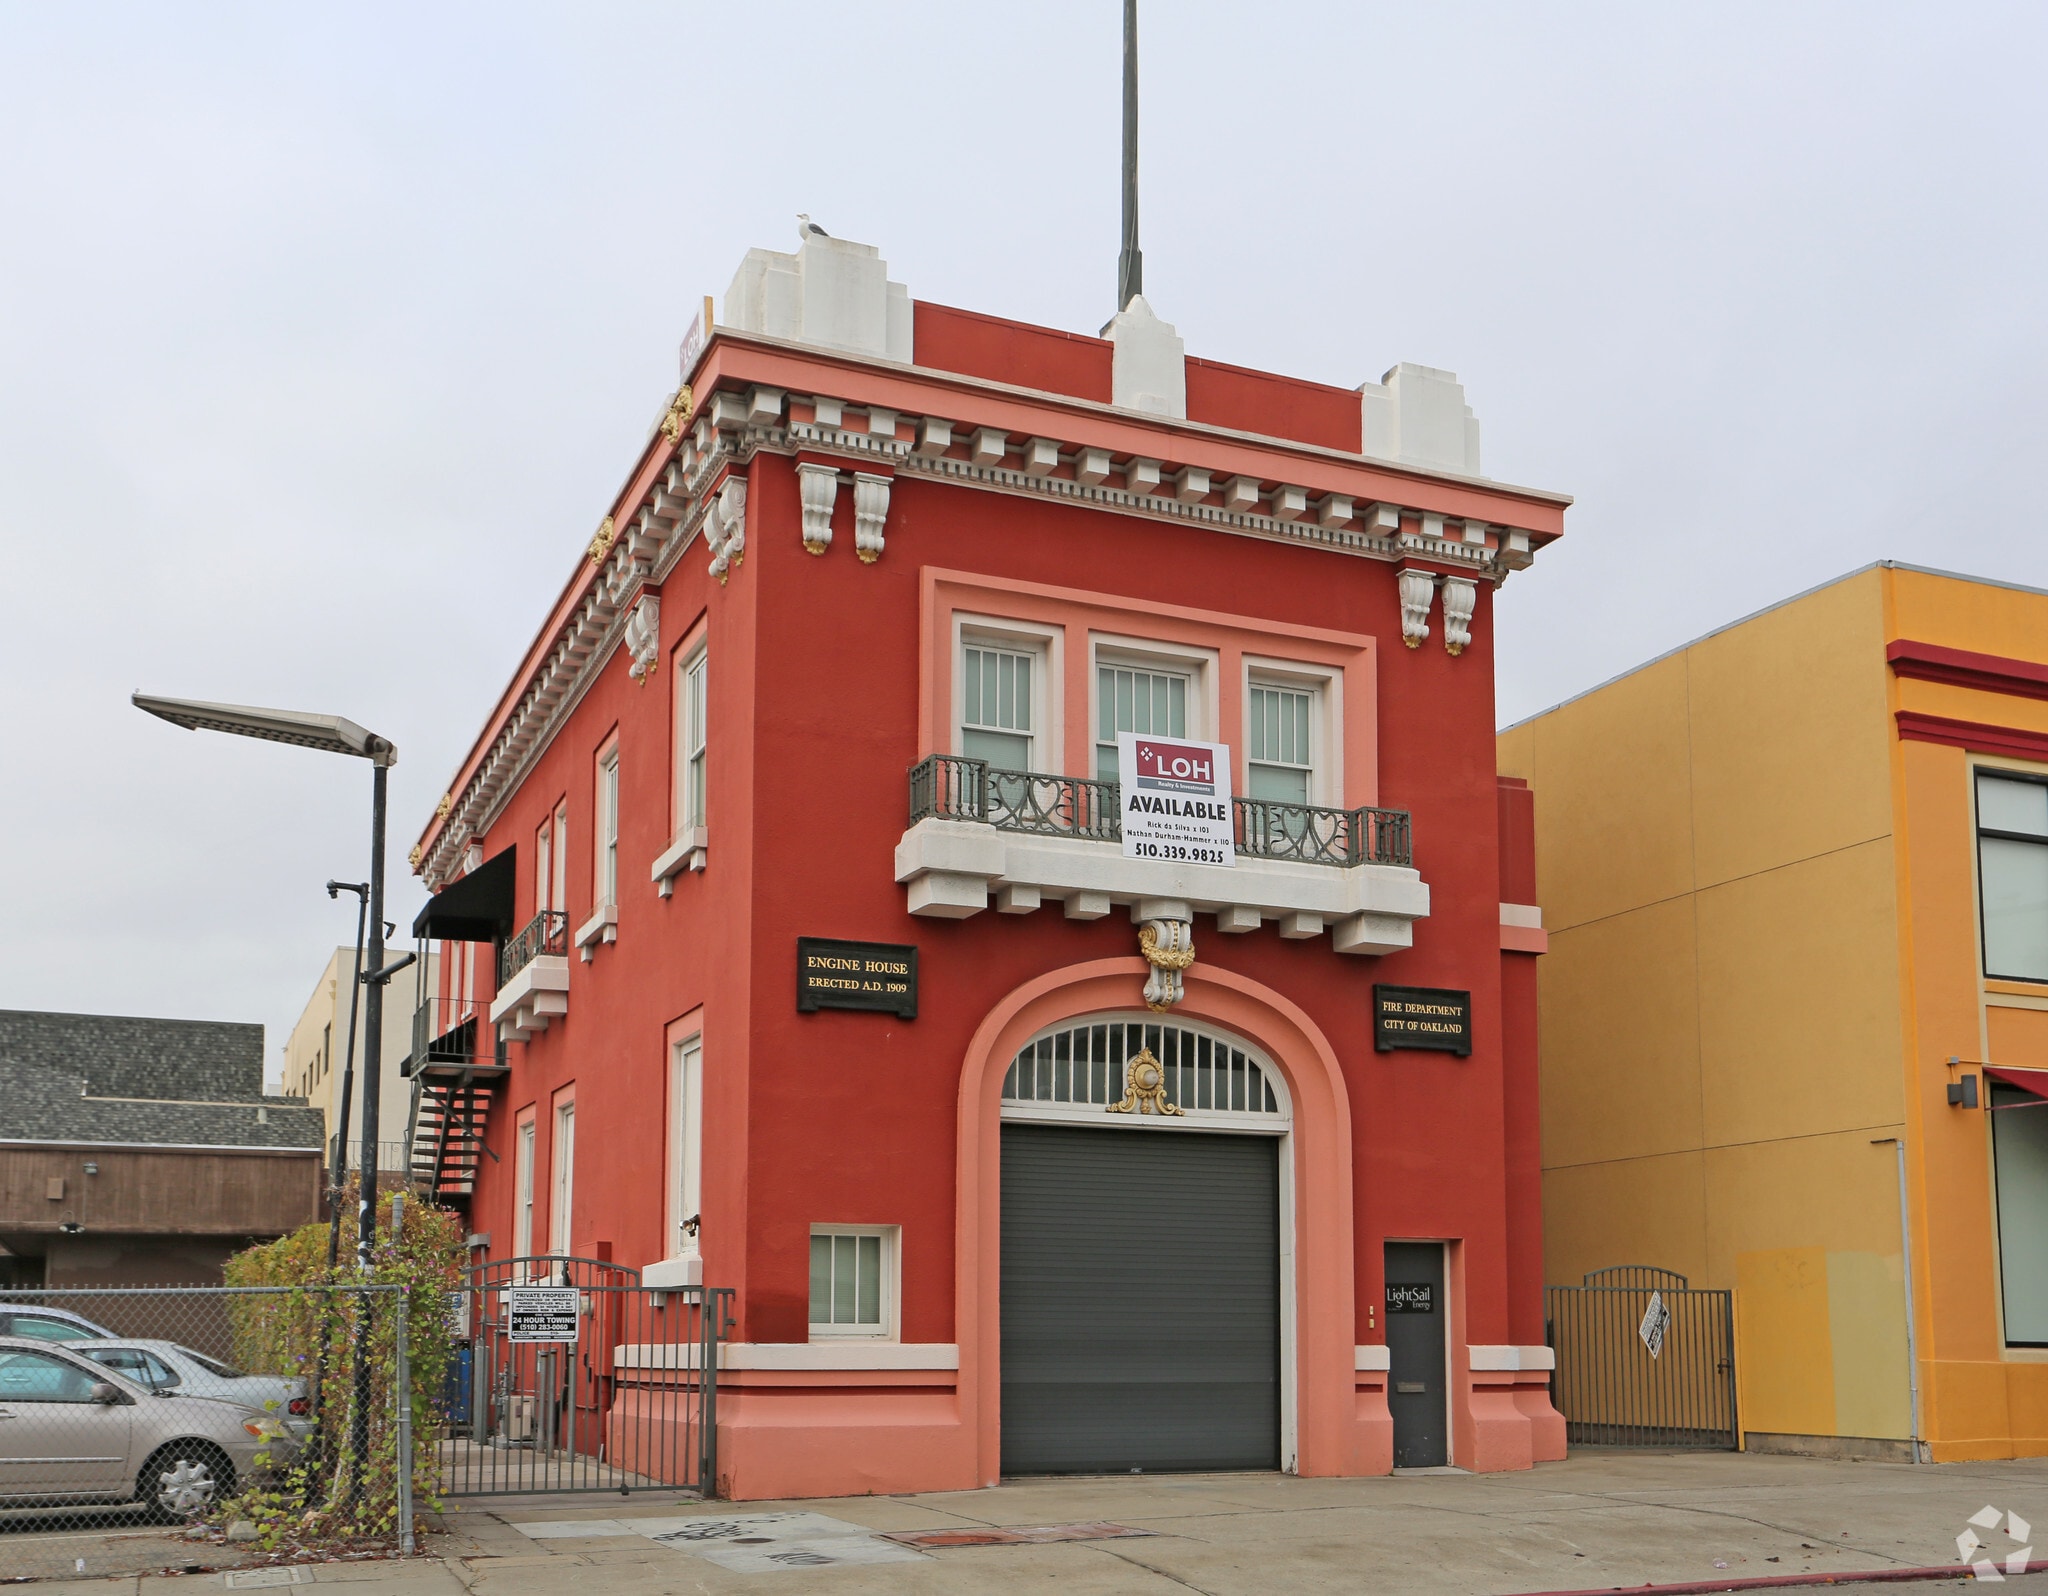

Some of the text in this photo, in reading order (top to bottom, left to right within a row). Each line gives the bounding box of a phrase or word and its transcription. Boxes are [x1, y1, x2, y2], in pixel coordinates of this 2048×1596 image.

[684, 325, 699, 365] LOH
[1157, 755, 1211, 781] LOH
[1157, 780, 1175, 789] Realty
[1180, 783, 1211, 792] Investments
[1128, 795, 1226, 821] AVAILABLE
[1147, 821, 1162, 829] Rick
[1175, 823, 1190, 832] Silva
[1199, 826, 1210, 834] 103
[1127, 829, 1152, 838] Nathan
[1155, 832, 1211, 844] Durham-Hammer
[1220, 838, 1230, 846] 110
[1135, 843, 1224, 863] 510.339.9825
[807, 956, 909, 975] ENGINE HOUSE
[808, 977, 907, 993] ERECTED A.D. 1909
[1383, 1001, 1463, 1017] FIRE DEPARTMENT
[1384, 1019, 1462, 1034] CITY OF OAKLAND
[1386, 1286, 1430, 1308] LightSail
[1412, 1301, 1431, 1310] Energy
